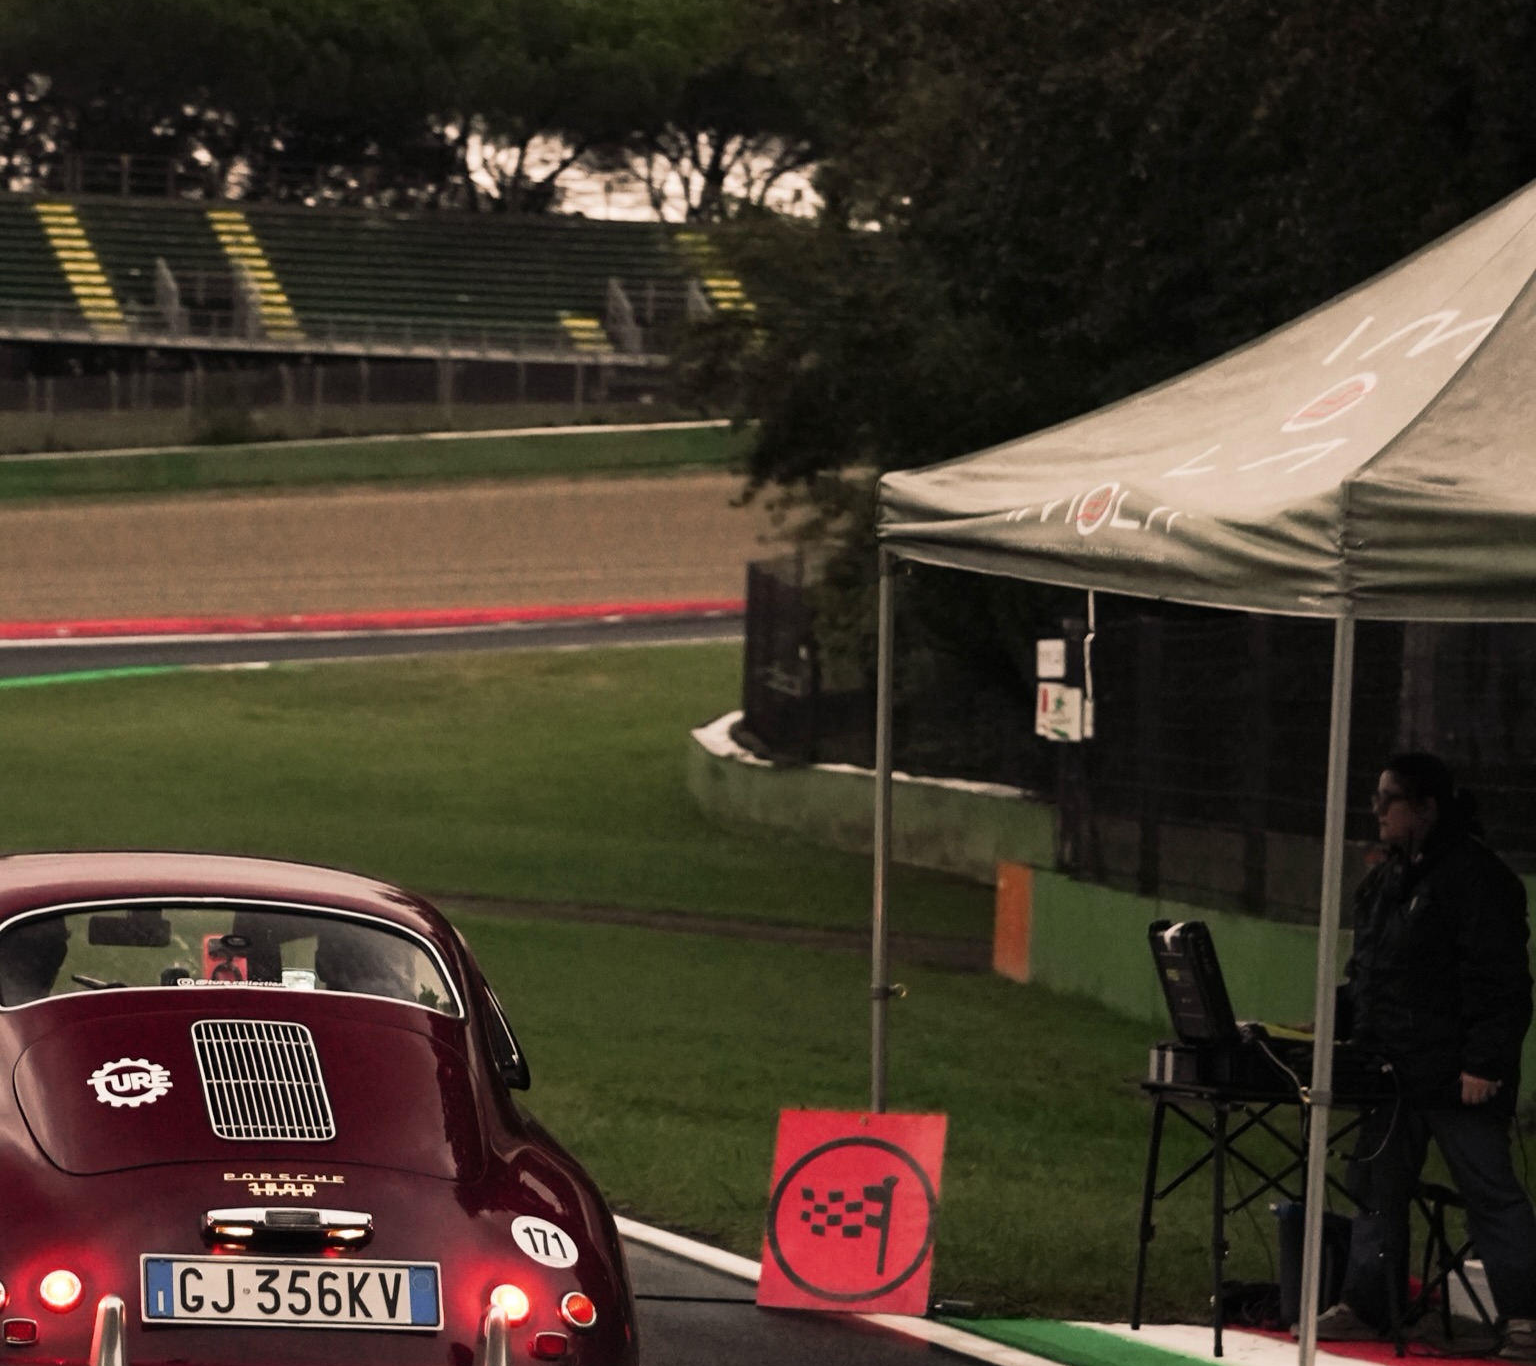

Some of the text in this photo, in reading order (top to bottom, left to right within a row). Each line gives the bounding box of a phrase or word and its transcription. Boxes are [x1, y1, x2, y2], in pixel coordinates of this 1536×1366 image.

[86, 1070, 174, 1093] TURE
[223, 1172, 345, 1184] PORSCHE
[522, 1226, 568, 1260] 171
[179, 1266, 235, 1314] GJ
[255, 1268, 402, 1319] 356KV
